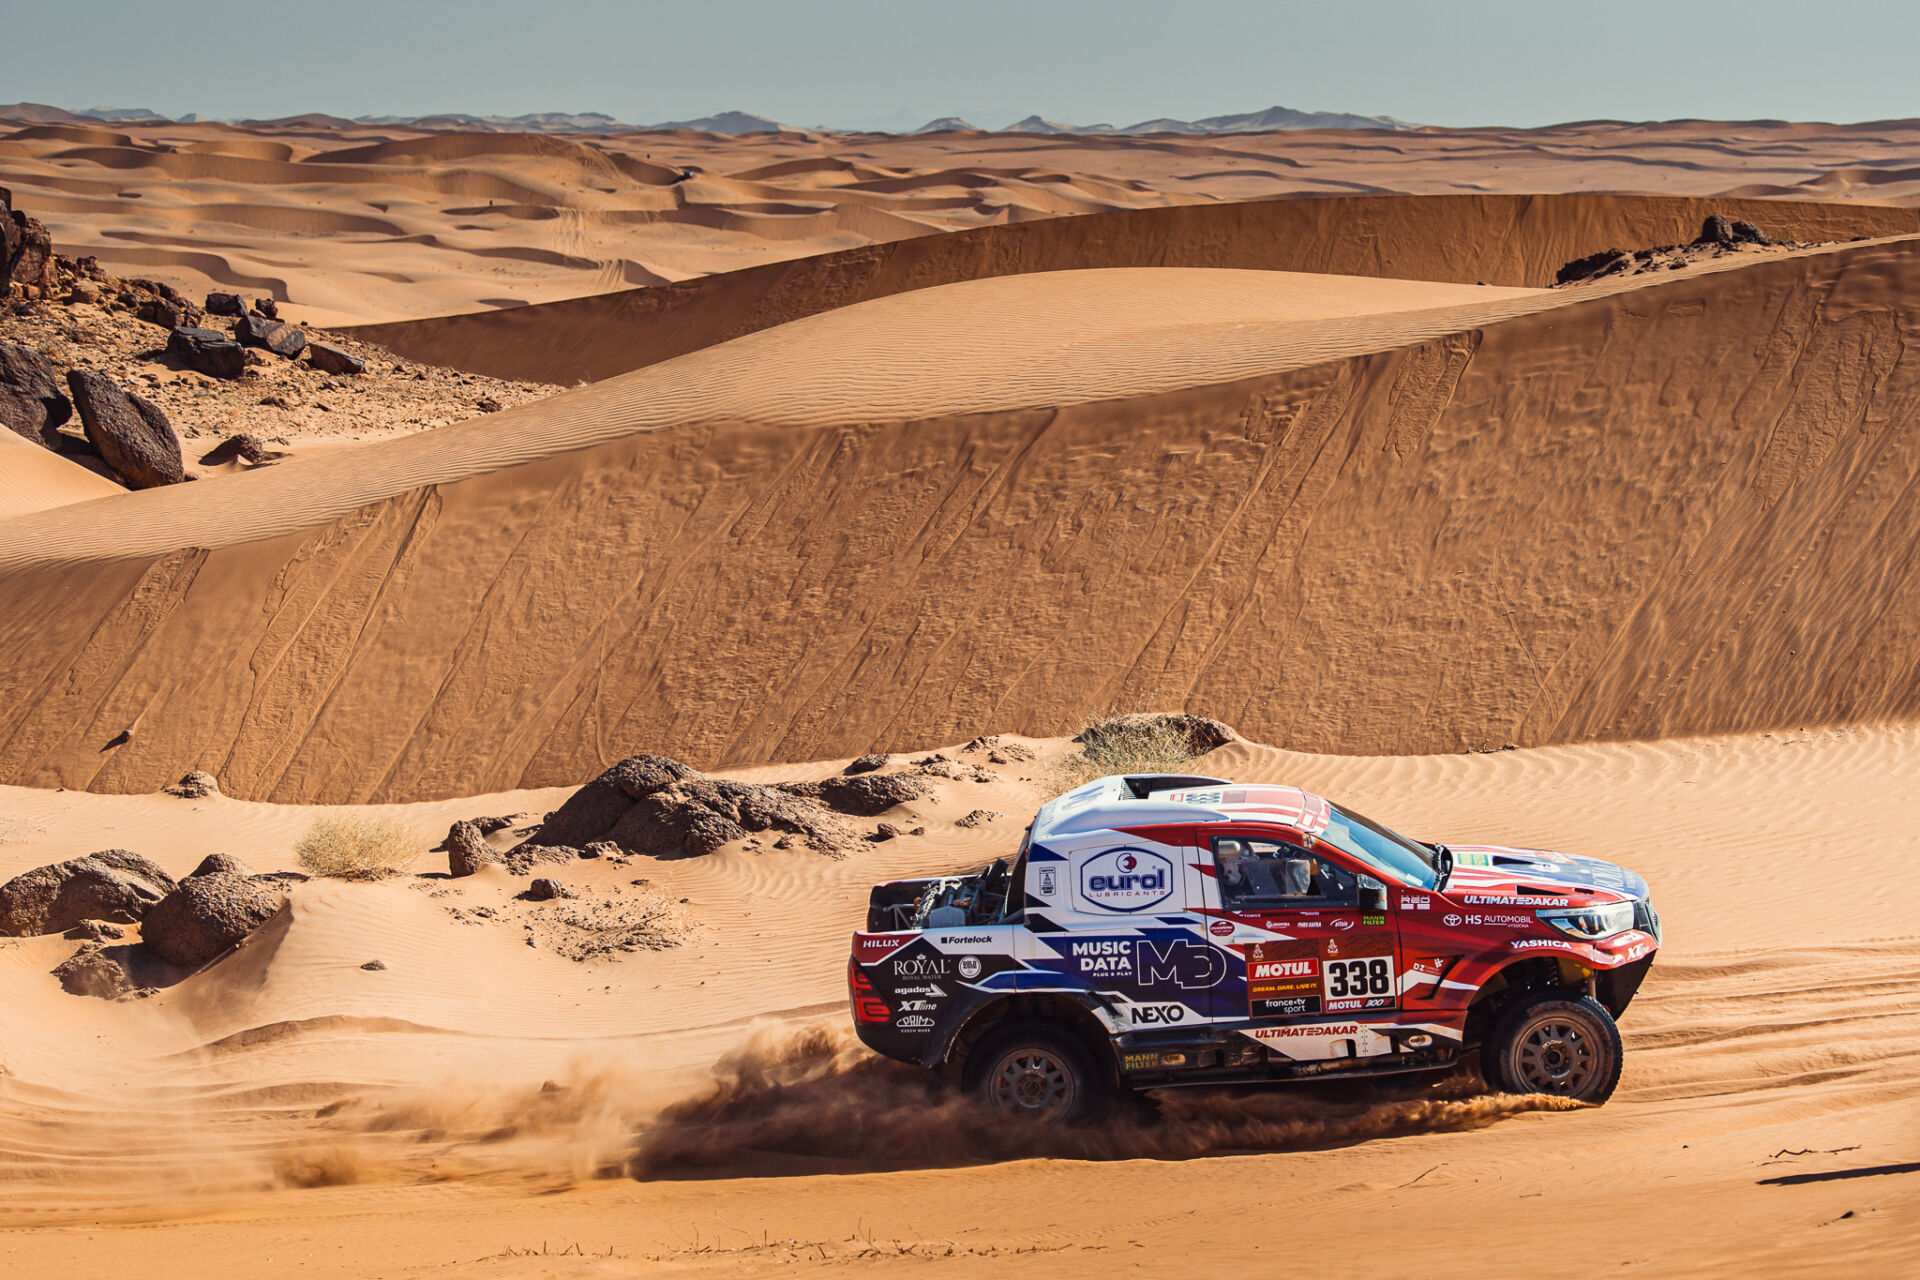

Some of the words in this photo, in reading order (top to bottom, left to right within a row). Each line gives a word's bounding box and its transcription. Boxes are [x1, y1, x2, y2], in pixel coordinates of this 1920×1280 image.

[1088, 868, 1165, 892] eurol
[1089, 890, 1165, 898] LUBRICANTS
[1465, 914, 1482, 925] HS
[1484, 914, 1534, 924] AUTOMOBIL
[862, 939, 900, 948] HILUX
[948, 935, 993, 944] Fortelock
[1510, 939, 1573, 950] YASHICA
[1072, 941, 1131, 956] MUSIC
[893, 958, 951, 976] ROYAL
[1080, 956, 1132, 971] DATA
[1254, 960, 1312, 978] MOTUL
[1413, 962, 1425, 972] DZ
[1328, 958, 1390, 997] 338
[894, 986, 932, 995] agados
[1283, 1005, 1306, 1014] sport
[1328, 1000, 1362, 1010] MOTUL
[1131, 1005, 1185, 1024] NEXO
[902, 1015, 929, 1027] PRIM
[1124, 1053, 1158, 1062] MANN
[1125, 1061, 1158, 1070] FILTER
